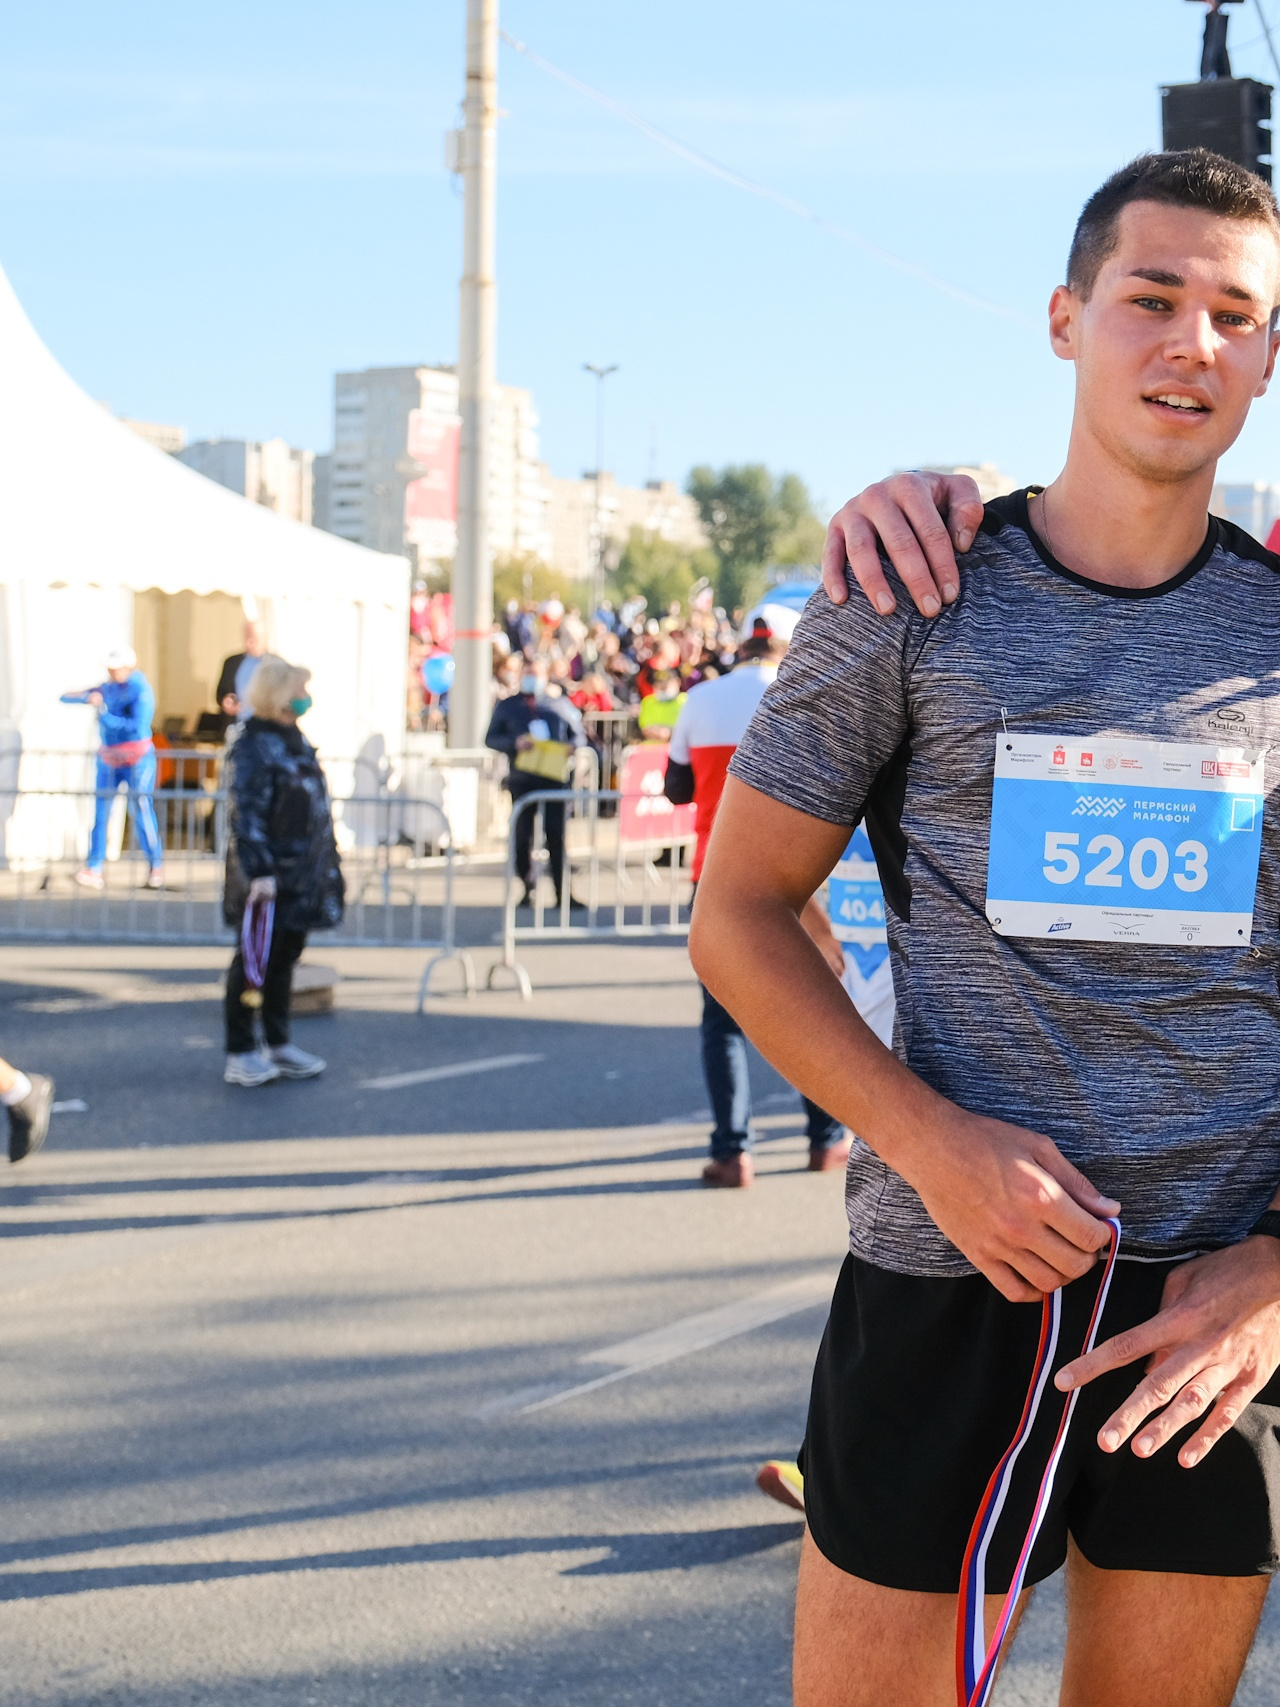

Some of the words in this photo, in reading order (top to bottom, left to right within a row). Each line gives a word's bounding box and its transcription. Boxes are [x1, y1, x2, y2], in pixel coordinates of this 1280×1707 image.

[1207, 719, 1254, 736] Kalenji
[1133, 800, 1197, 813] ПЕРМСКИЙ
[1133, 812, 1190, 823] МАРАФОН
[1042, 831, 1209, 893] 5203
